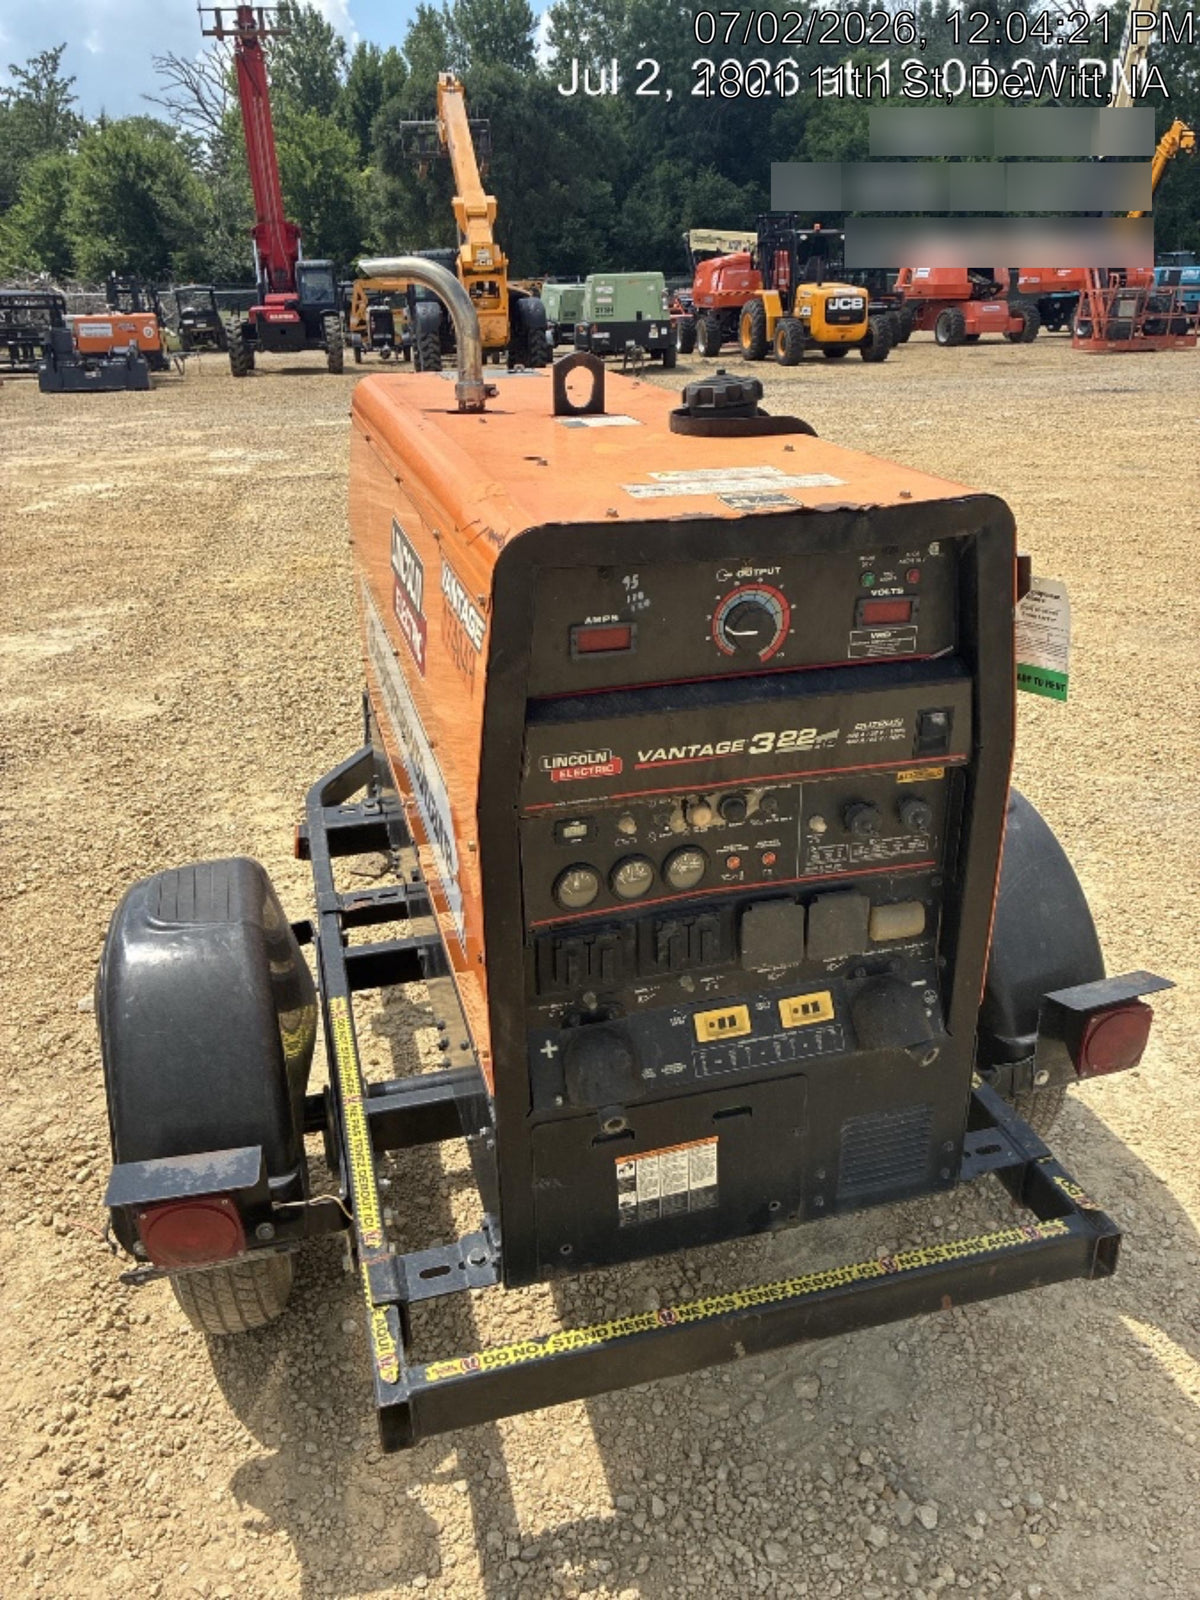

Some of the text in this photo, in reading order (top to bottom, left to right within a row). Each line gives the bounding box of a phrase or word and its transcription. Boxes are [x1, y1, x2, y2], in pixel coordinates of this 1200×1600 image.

[828, 297, 864, 311] JCB
[736, 566, 782, 577] OUTPUT
[870, 587, 904, 597] VOLTS
[584, 614, 620, 625] AMPS
[637, 739, 746, 762] VANTAGE
[749, 728, 818, 754] 322
[543, 751, 607, 769] LINCOLN
[559, 764, 614, 778] ELECTRIC
[900, 1231, 1022, 1266] NO SE PARE AQUI
[679, 1265, 879, 1318] NE PAS TENEZ DEBOUT ICI
[375, 1318, 391, 1353] AQUI
[483, 1351, 510, 1366] DO
[552, 1329, 609, 1348] STAND
[612, 1316, 658, 1334] HERE
